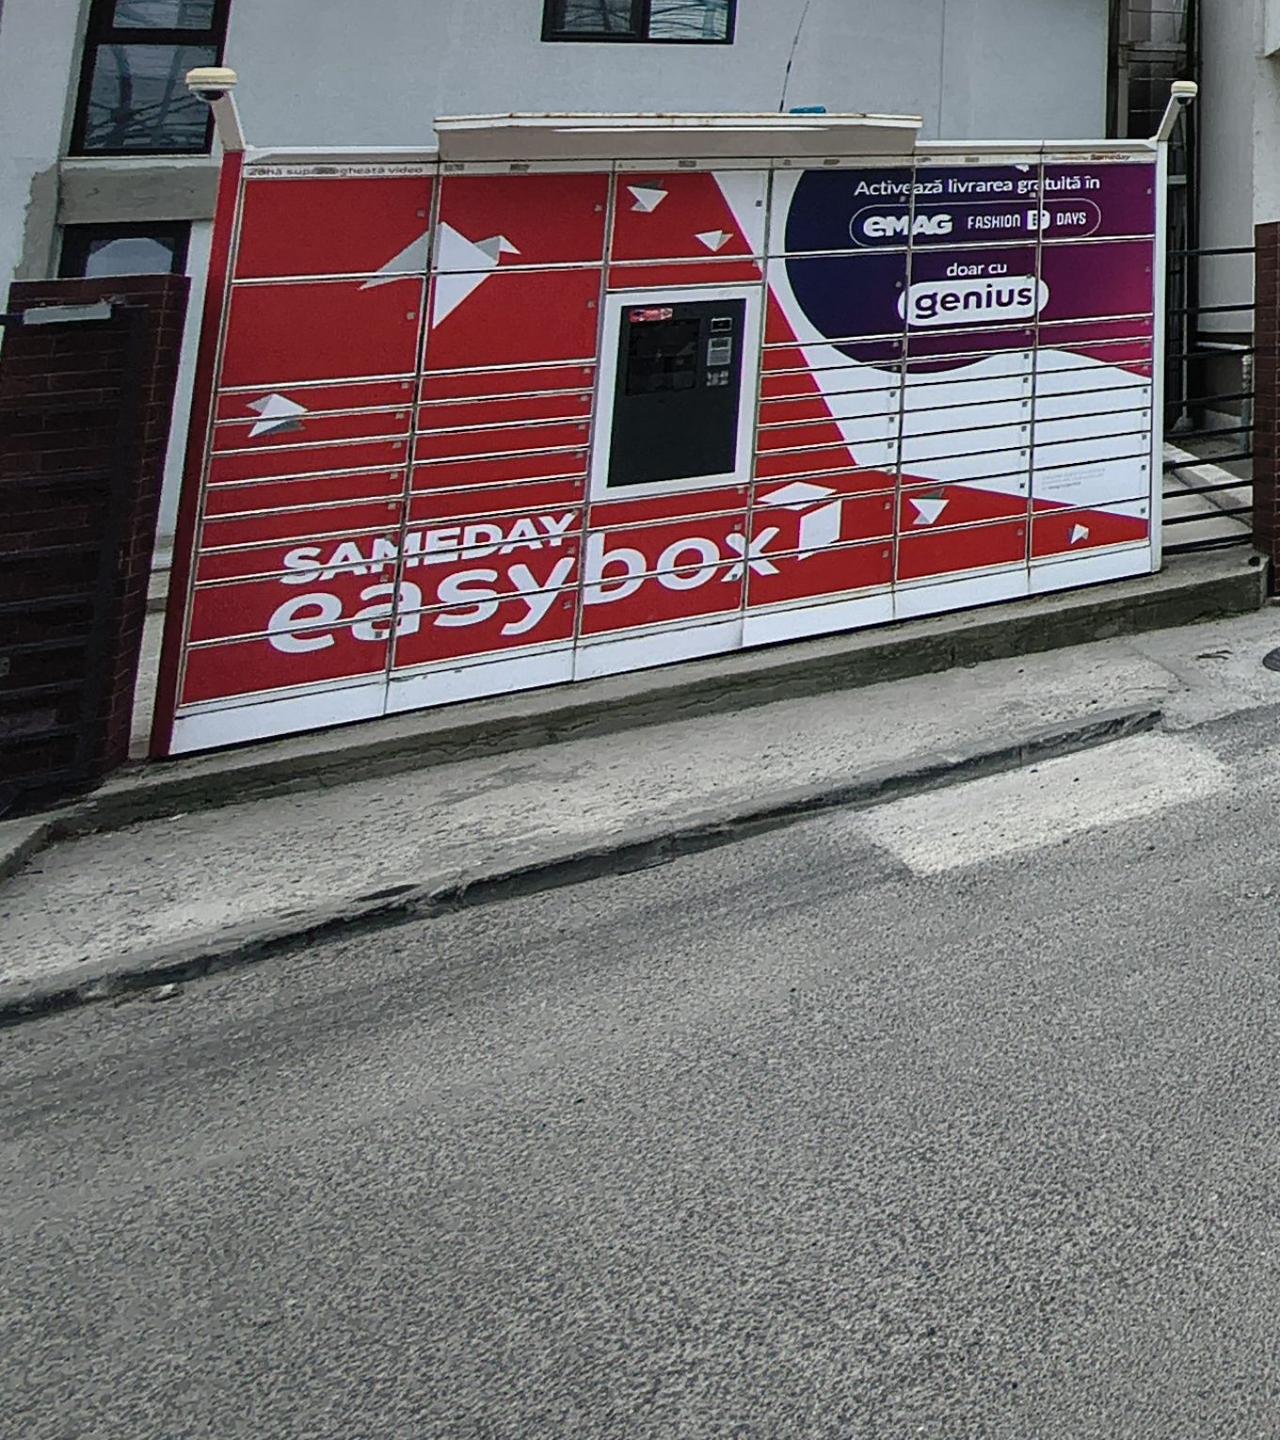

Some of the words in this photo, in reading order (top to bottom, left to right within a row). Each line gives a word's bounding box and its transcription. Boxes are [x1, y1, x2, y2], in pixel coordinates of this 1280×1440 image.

[853, 179, 943, 197] Activează
[948, 176, 1013, 193] livrarea
[1017, 176, 1081, 194] gratuită
[1085, 175, 1101, 191] în
[967, 214, 1021, 229] FASHION
[1056, 212, 1087, 227] DAYS
[946, 261, 984, 278] doar
[988, 263, 1008, 277] cu
[914, 283, 1034, 320] genius
[278, 513, 577, 584] SAMEDAY
[267, 526, 782, 653] easybox
